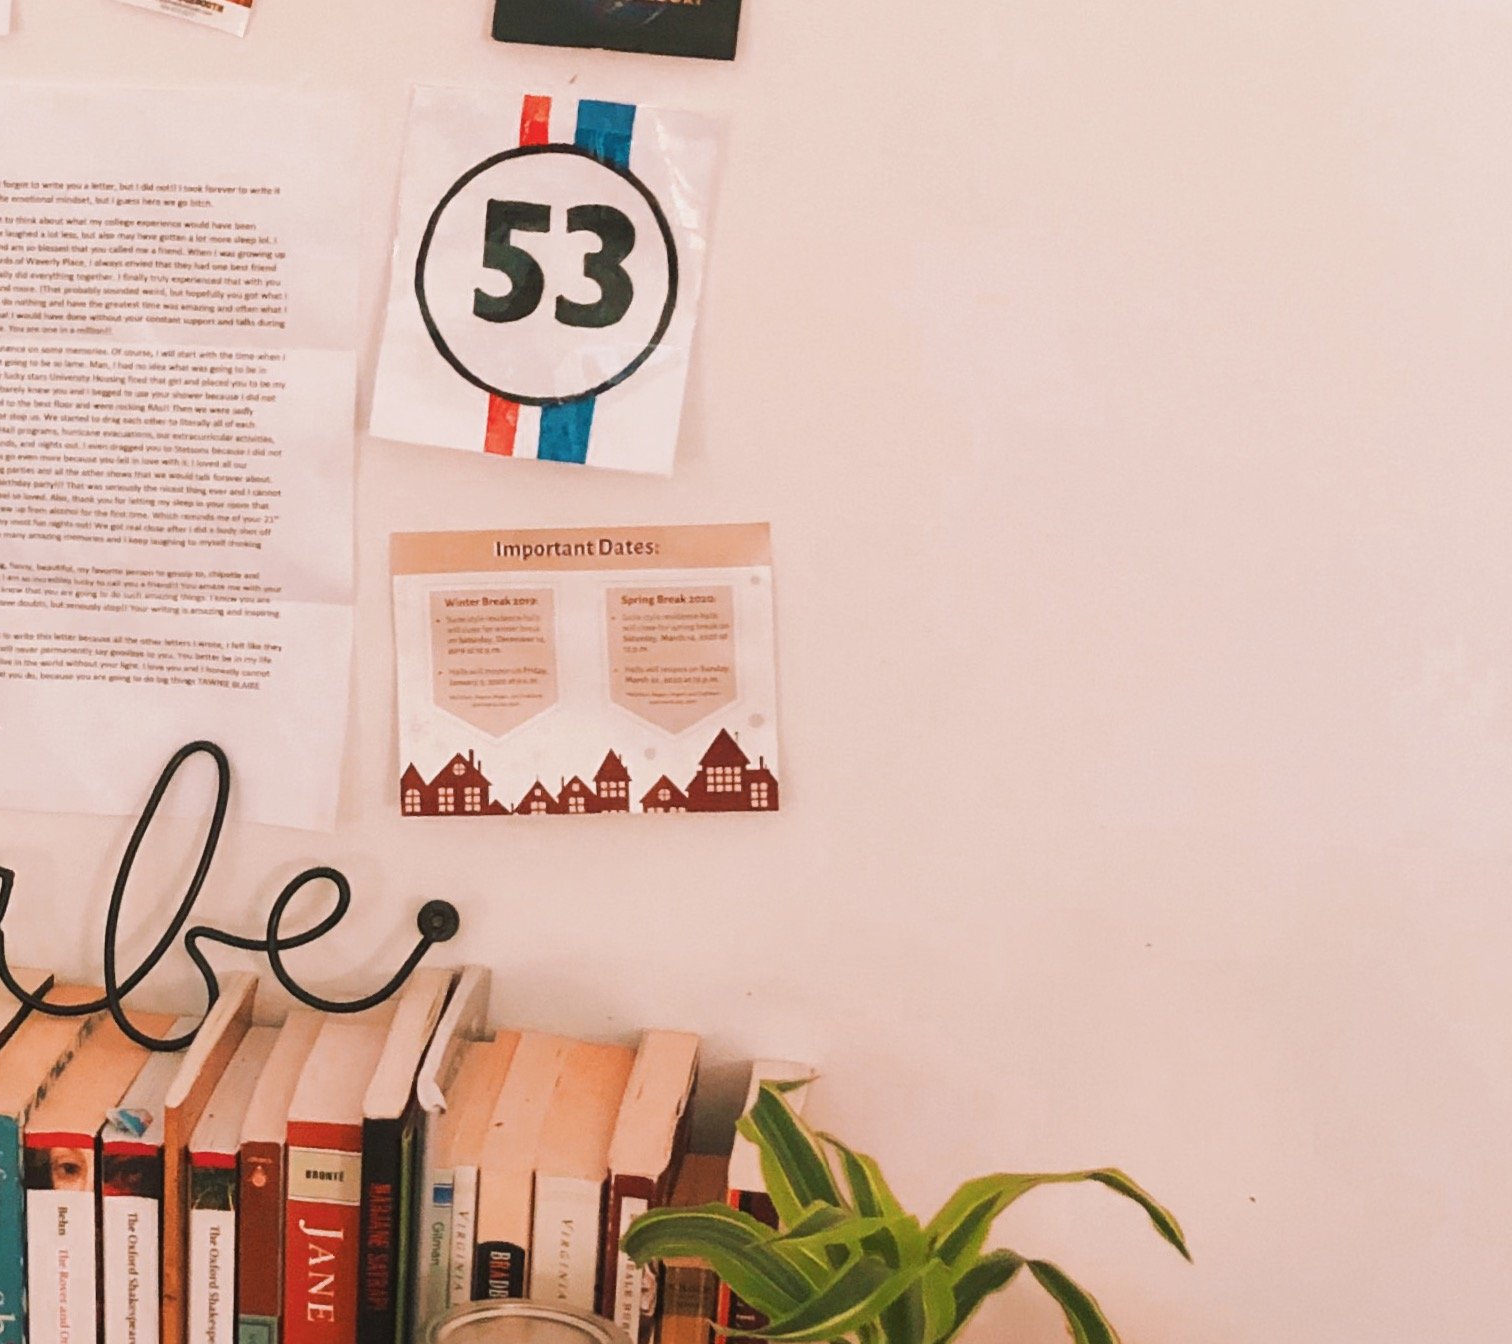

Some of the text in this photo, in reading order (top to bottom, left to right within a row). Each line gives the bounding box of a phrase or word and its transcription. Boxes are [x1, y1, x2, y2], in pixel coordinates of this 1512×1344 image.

[472, 198, 636, 329] 53
[495, 537, 661, 561] Important Dates:
[444, 597, 480, 607] Winter
[482, 596, 511, 606] Break
[621, 595, 654, 606] Spring
[657, 594, 686, 604] Break
[208, 1226, 220, 1246] The
[430, 1222, 446, 1266] Gilman
[454, 1211, 470, 1292] VIRGINIA
[208, 1248, 220, 1288] Oxford
[298, 1219, 344, 1322] JANE
[557, 1219, 574, 1300] VIRGINIA
